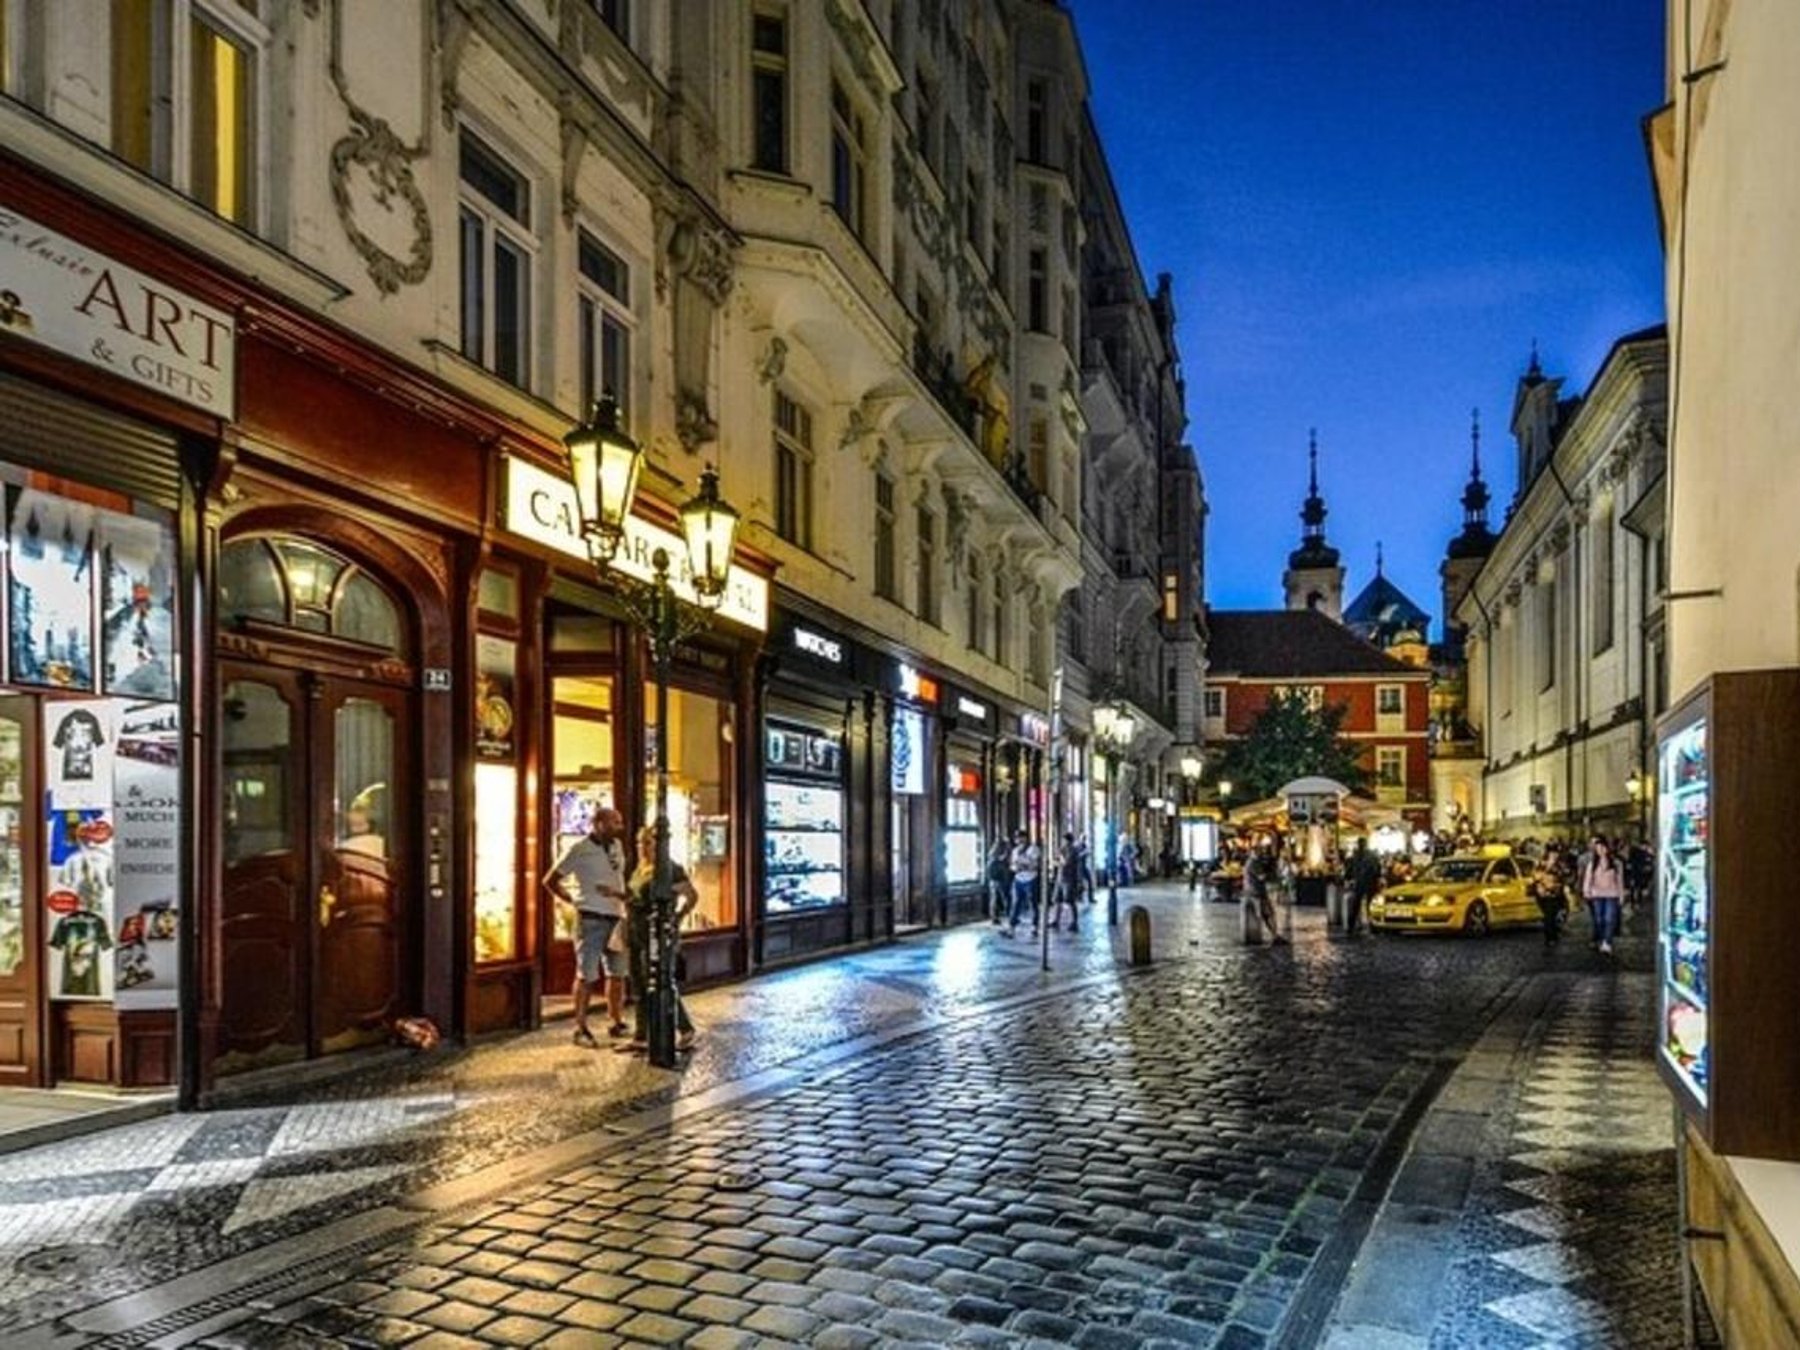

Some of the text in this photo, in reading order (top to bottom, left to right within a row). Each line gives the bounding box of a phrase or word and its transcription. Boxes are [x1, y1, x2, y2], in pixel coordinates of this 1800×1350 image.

[74, 268, 231, 372] ART
[90, 337, 214, 402] & GIFTS
[124, 837, 174, 850] MORE
